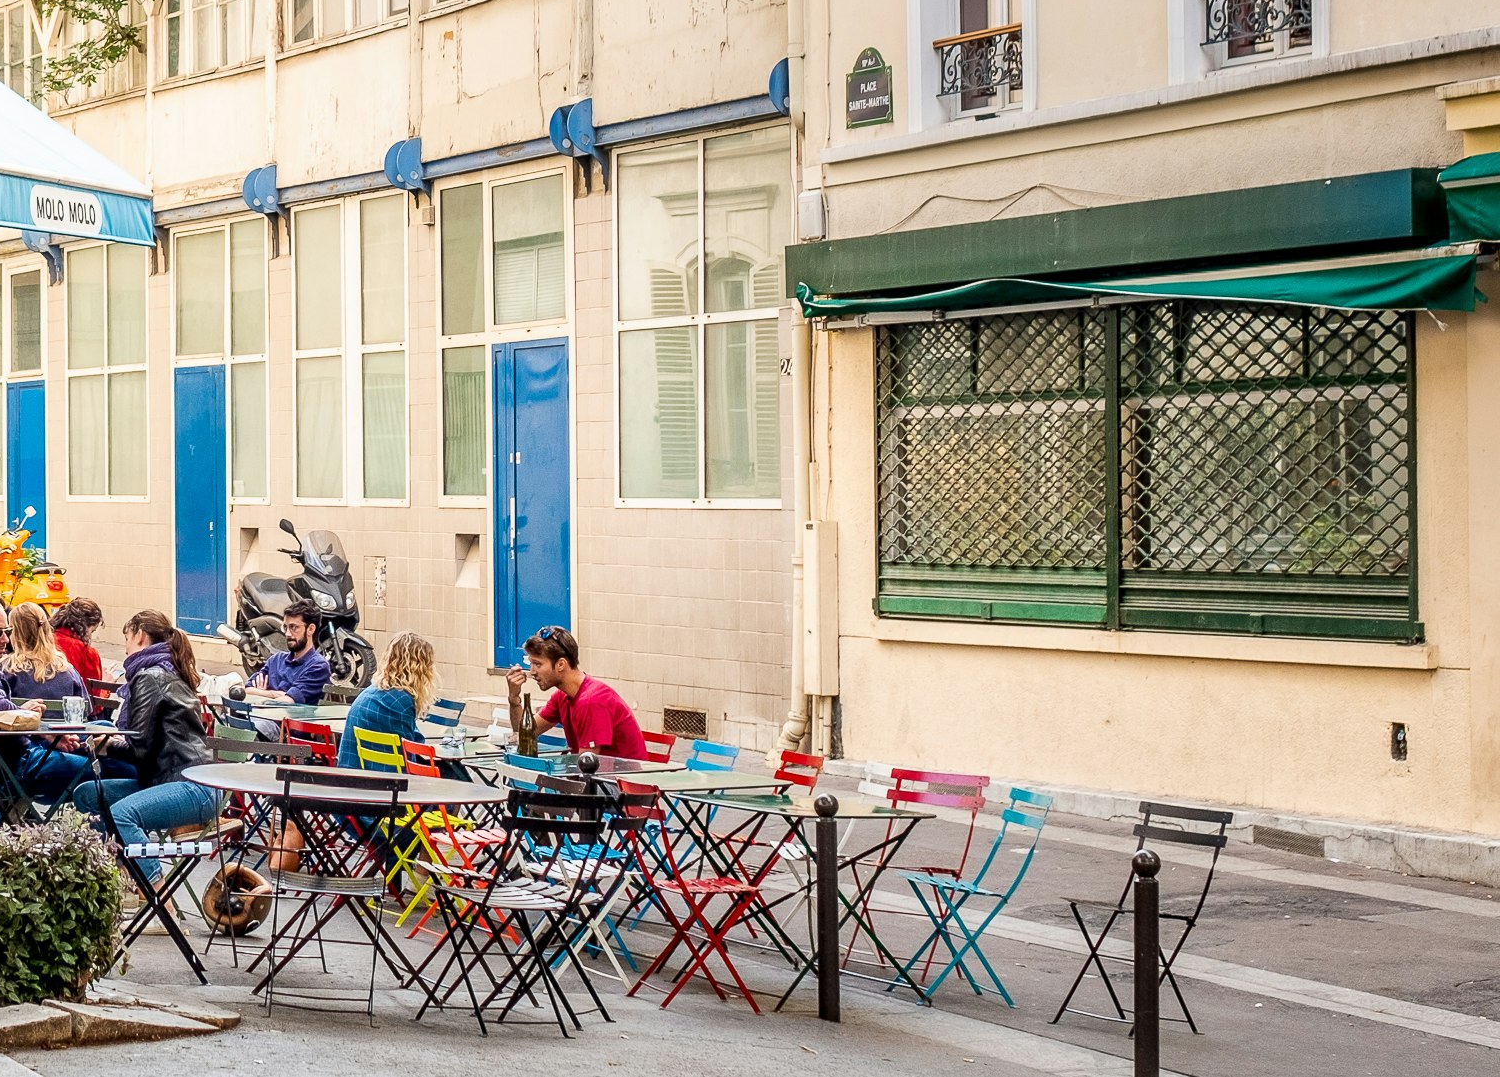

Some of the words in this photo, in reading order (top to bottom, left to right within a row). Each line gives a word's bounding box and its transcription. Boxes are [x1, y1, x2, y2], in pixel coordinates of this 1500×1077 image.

[860, 81, 876, 93] PLACE
[849, 95, 889, 111] SAINTE-MARTHE
[36, 196, 65, 222] MOLO
[68, 201, 96, 225] MOLO
